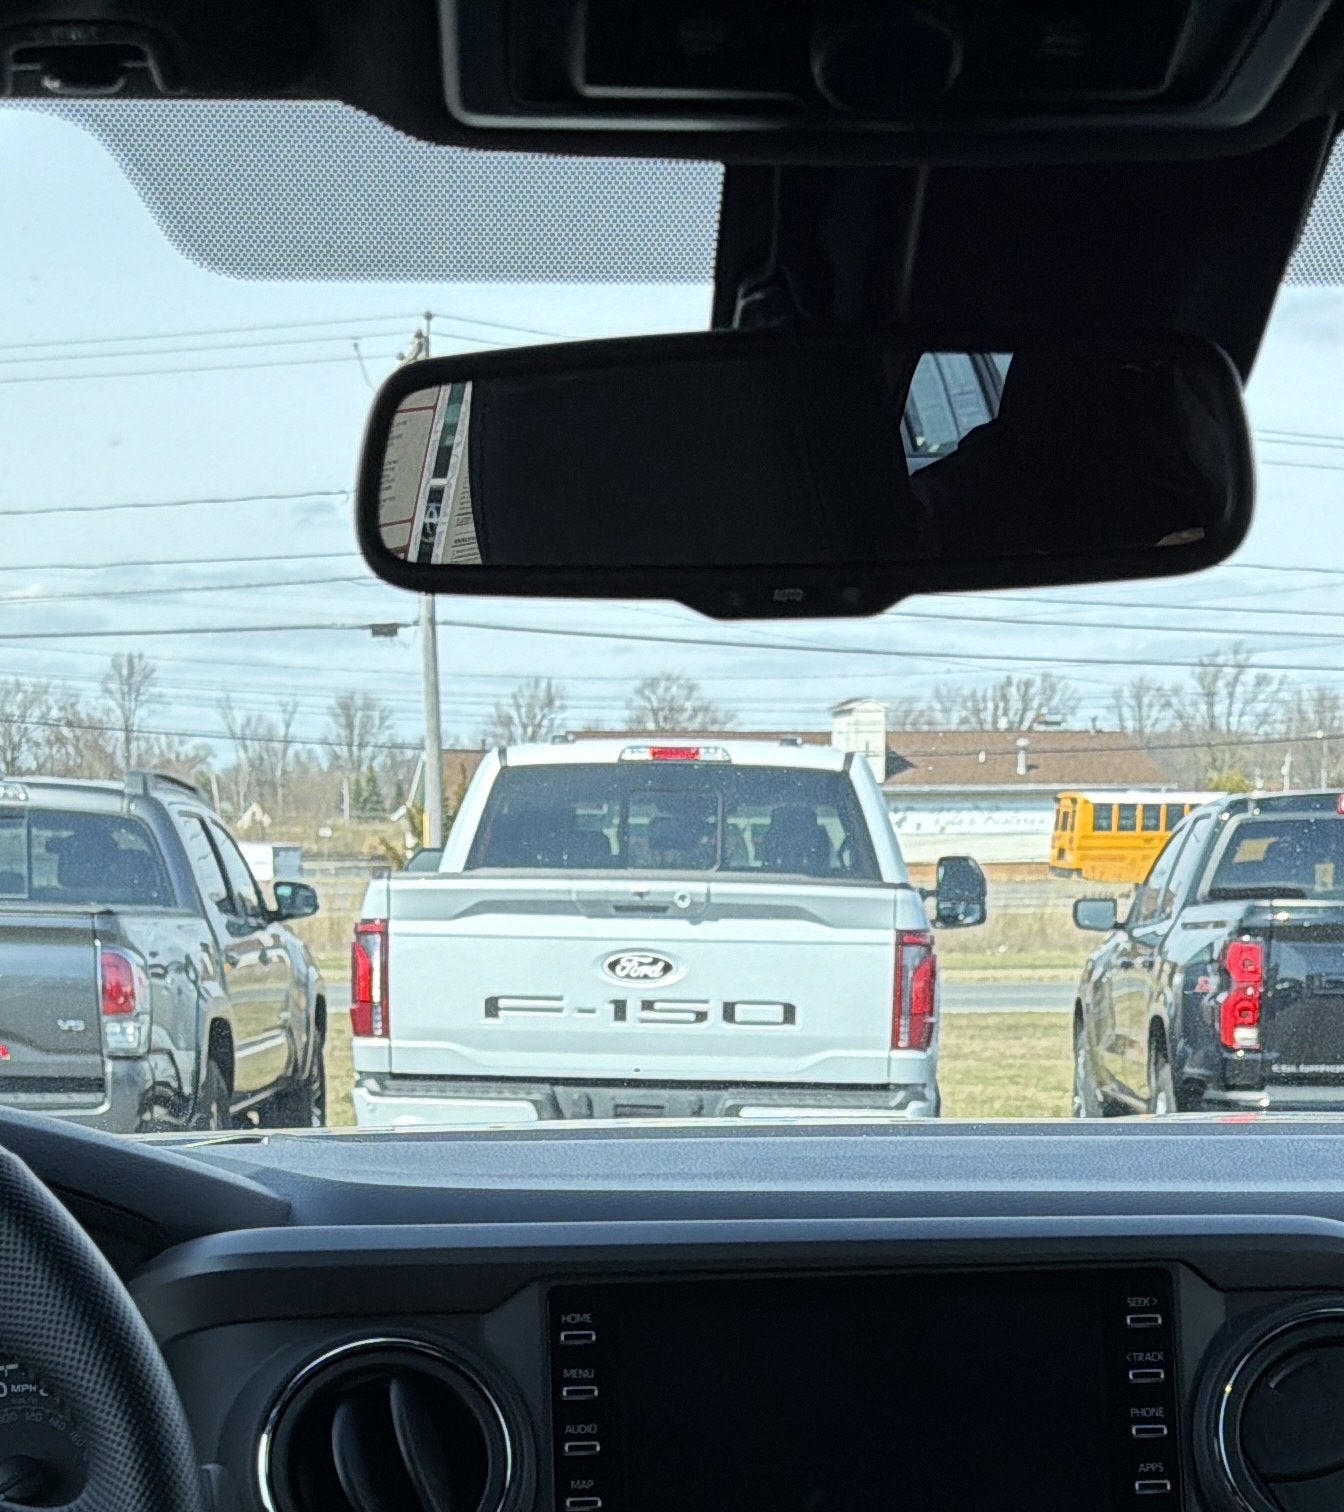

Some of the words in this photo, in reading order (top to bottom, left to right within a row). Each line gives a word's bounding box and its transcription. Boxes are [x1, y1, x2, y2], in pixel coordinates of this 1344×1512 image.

[614, 955, 665, 980] Ford
[483, 995, 797, 1026] F-150
[562, 1367, 596, 1380] MENU
[10, 1383, 38, 1394] MPH
[1128, 1406, 1165, 1418] PHONE
[564, 1422, 599, 1435] AUDIO
[1137, 1461, 1166, 1474] APPS
